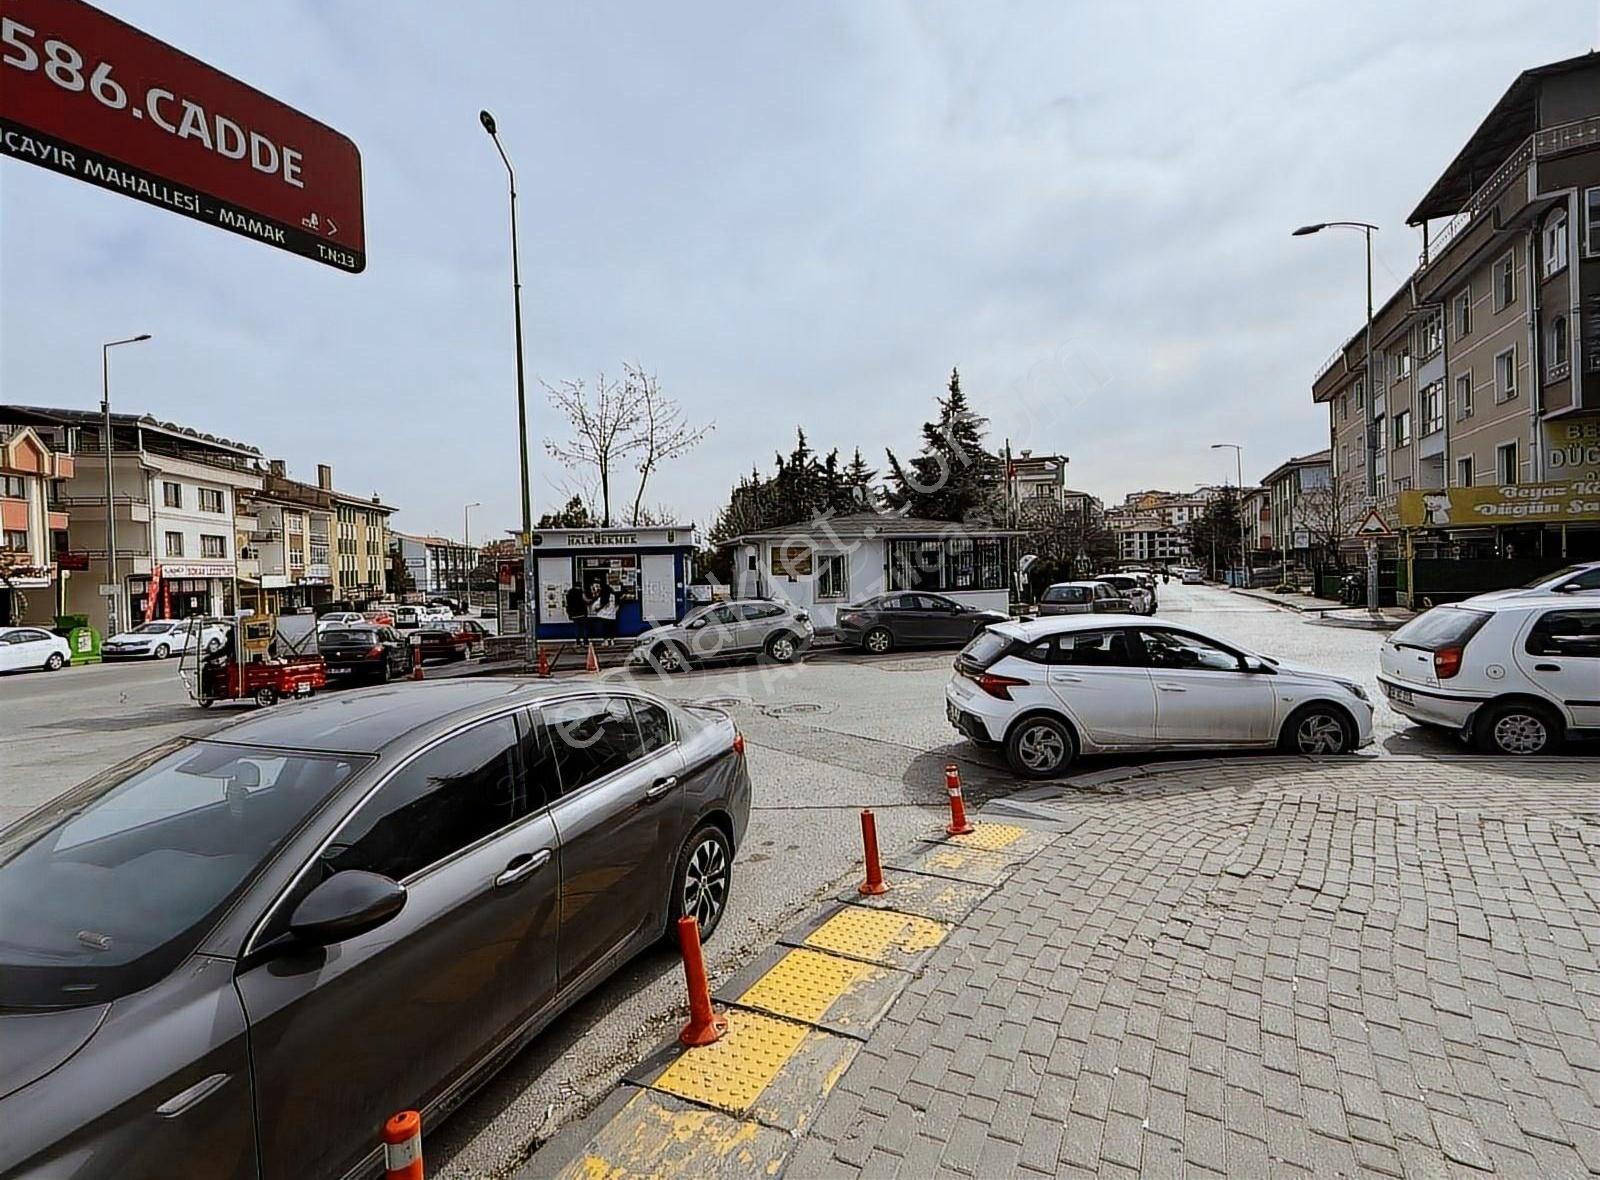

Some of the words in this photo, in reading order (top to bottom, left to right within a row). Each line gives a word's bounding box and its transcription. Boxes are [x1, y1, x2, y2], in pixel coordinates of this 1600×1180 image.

[1, 16, 305, 189] 586.CADDE
[0, 130, 76, 171] ÇAYIR
[84, 158, 201, 214] MAHALLESİ
[219, 207, 287, 244] MAMAK
[316, 243, 356, 269] T.N:13
